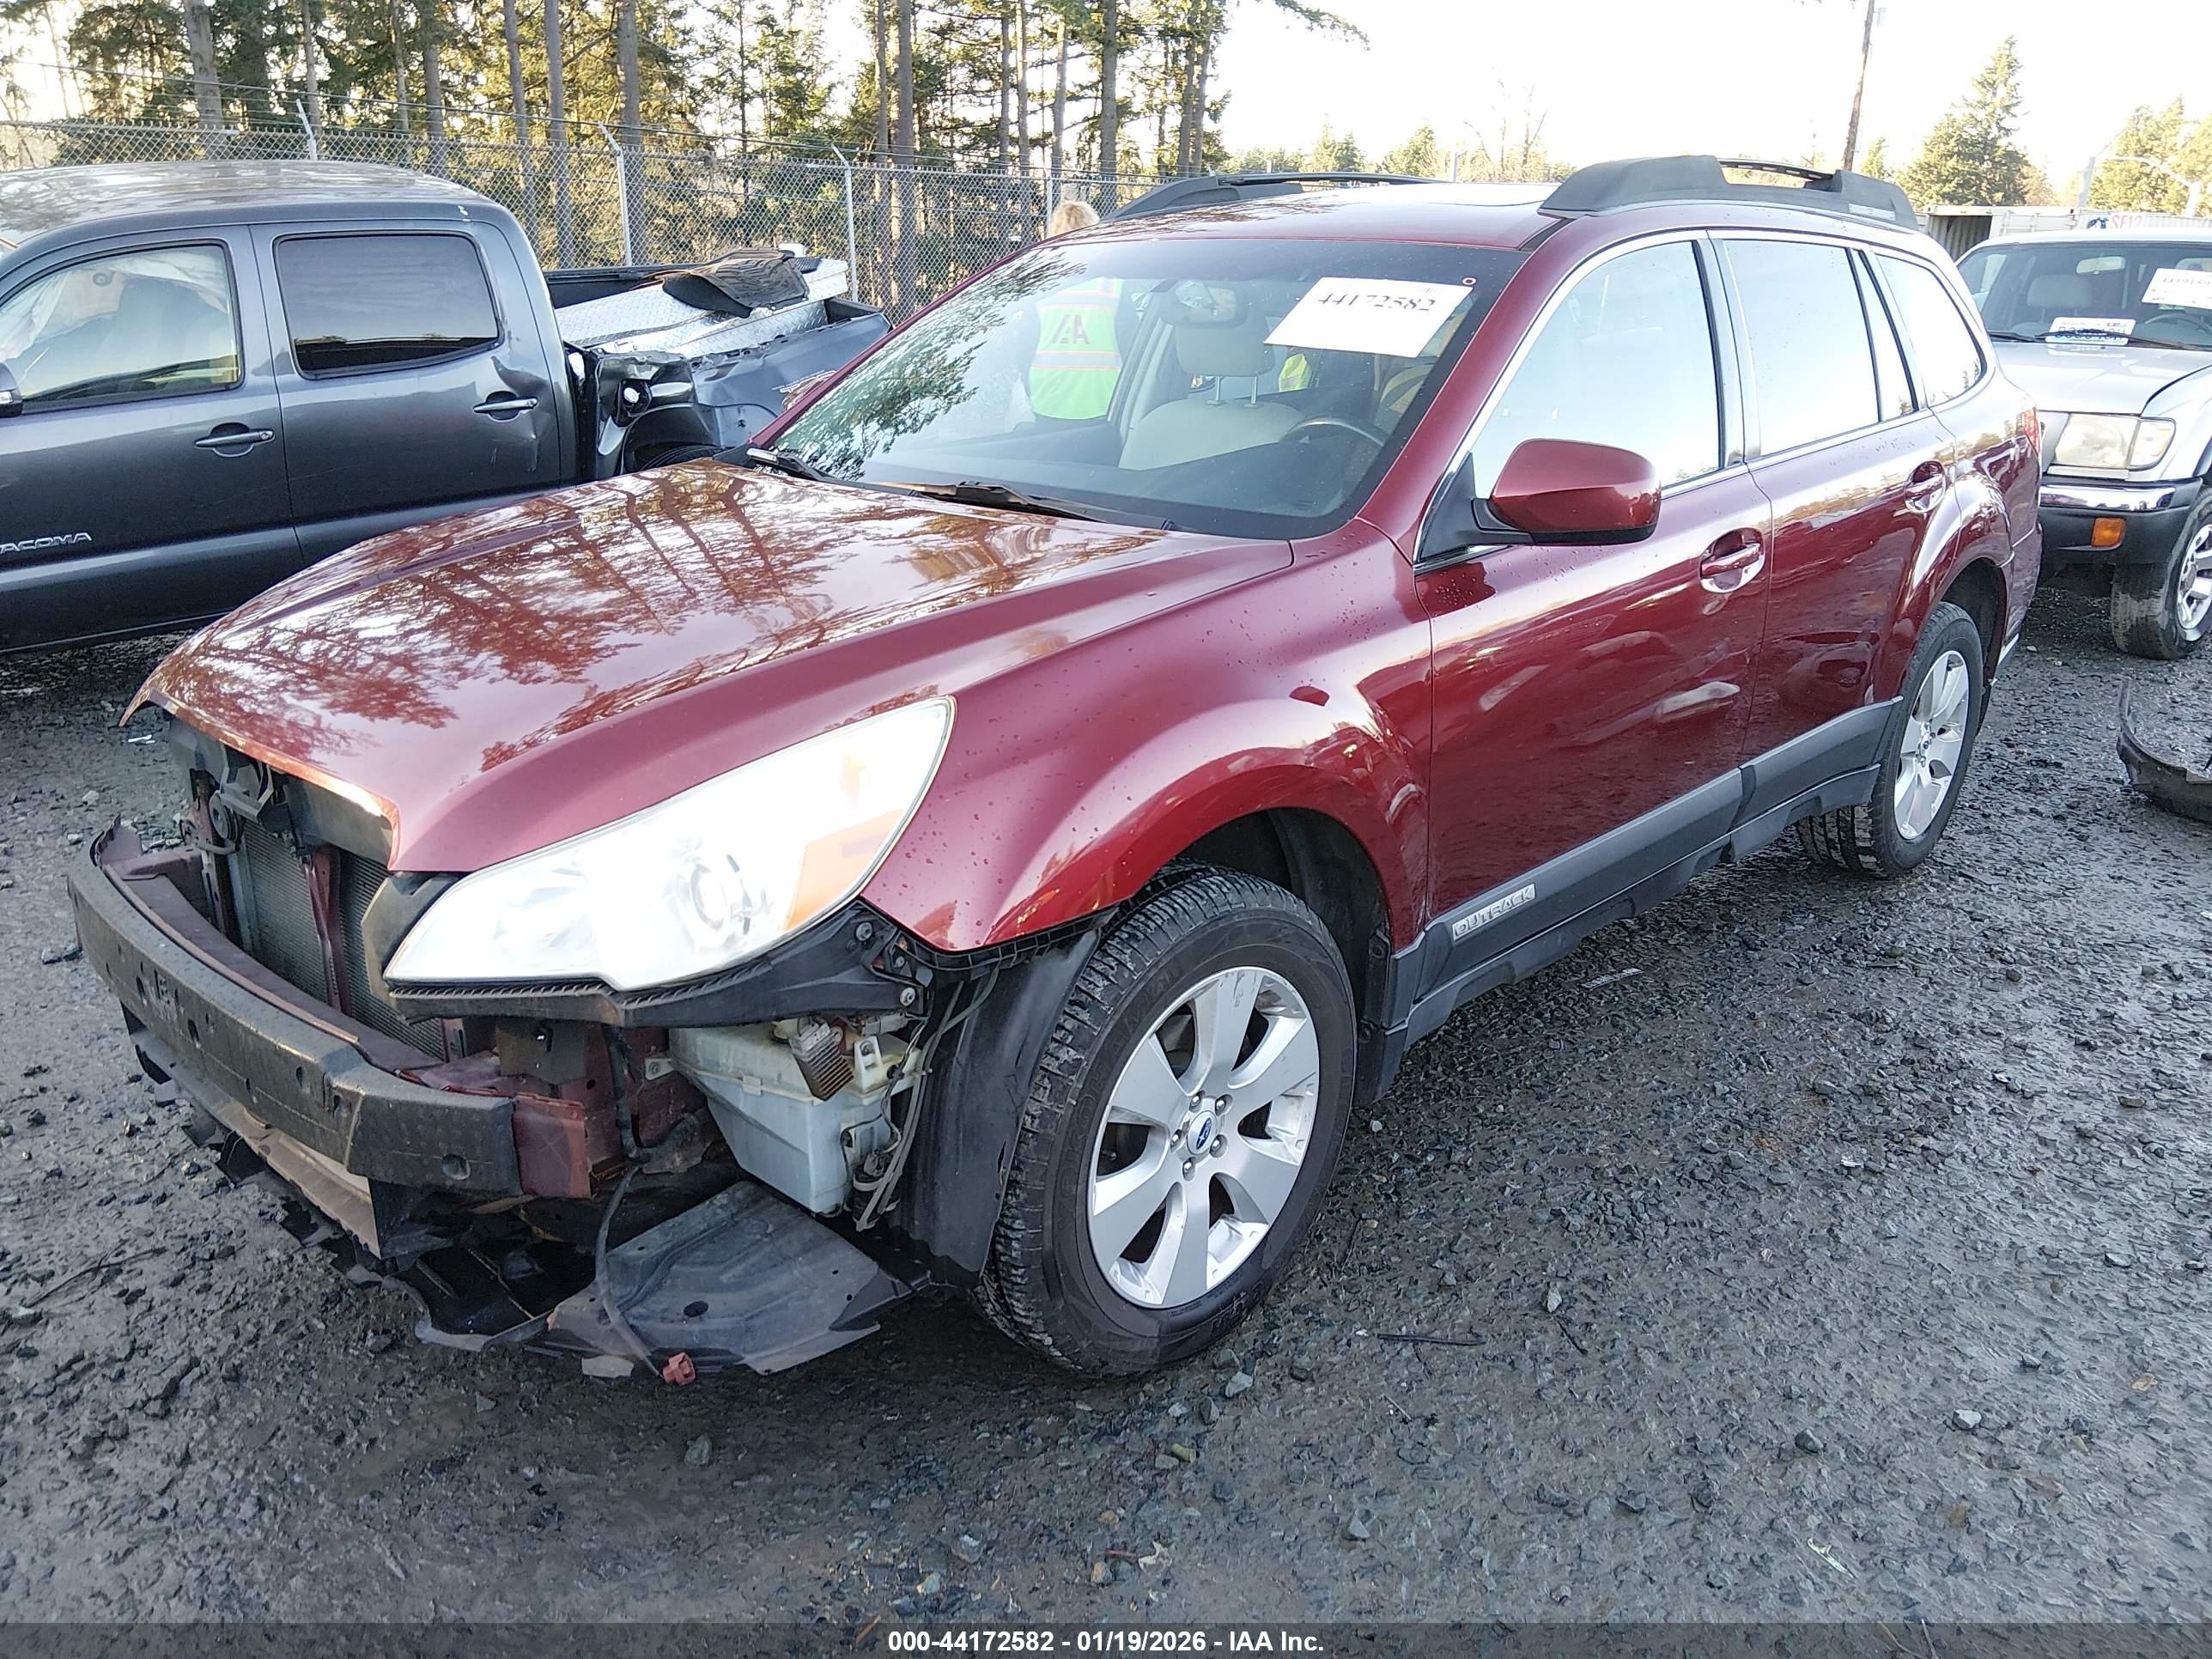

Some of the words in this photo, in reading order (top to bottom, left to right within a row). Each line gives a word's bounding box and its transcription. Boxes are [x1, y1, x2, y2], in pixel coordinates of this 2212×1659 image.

[1316, 292, 1436, 312] 44172582
[0, 532, 92, 555] ACOMA
[1454, 886, 1534, 937] OUTBACK
